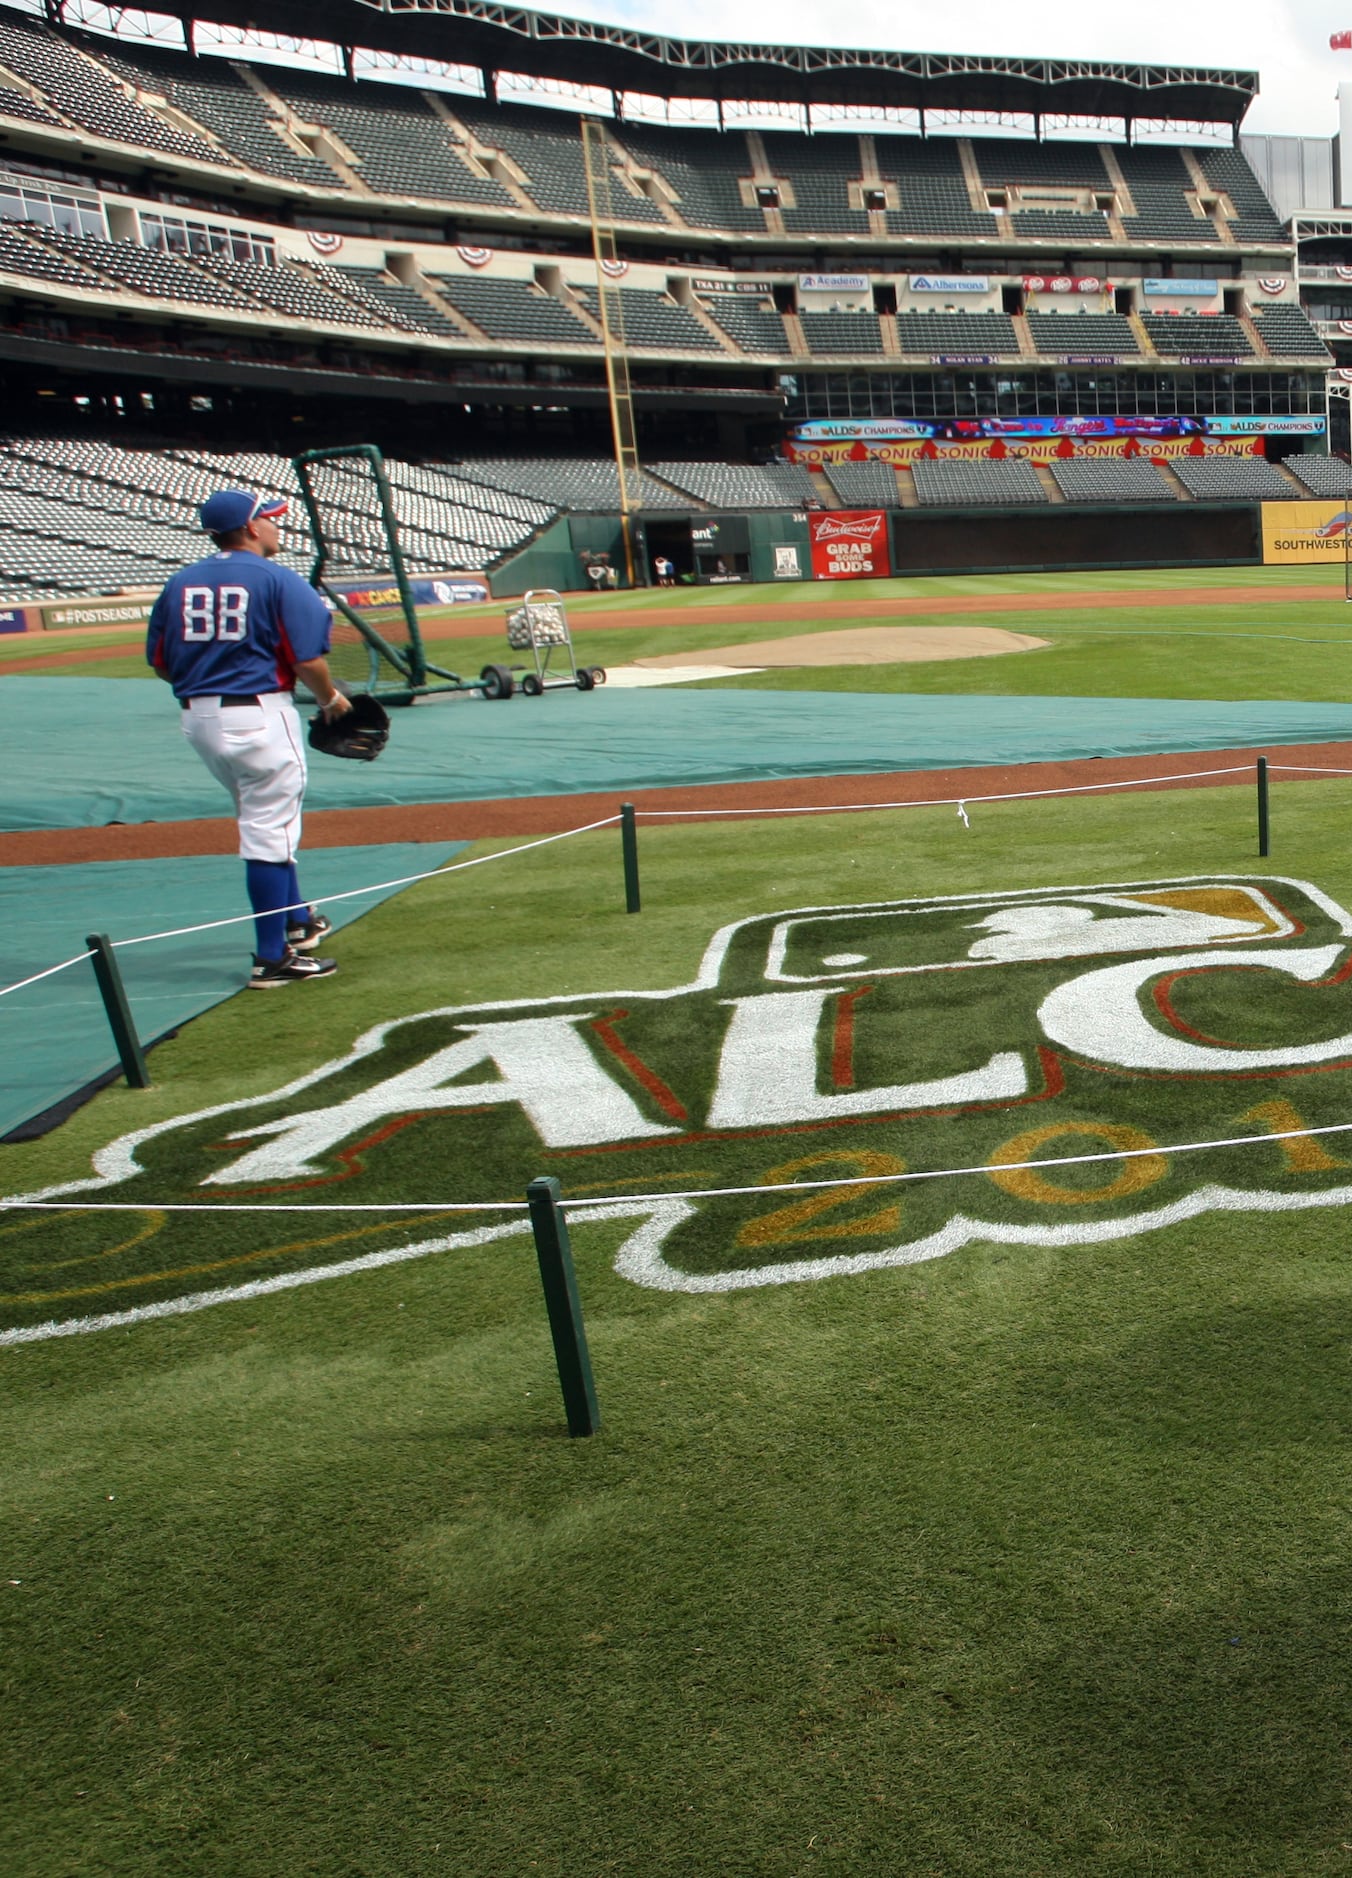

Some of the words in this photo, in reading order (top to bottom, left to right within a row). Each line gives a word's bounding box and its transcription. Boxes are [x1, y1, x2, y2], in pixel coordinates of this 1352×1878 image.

[817, 276, 864, 288] Academy
[933, 279, 985, 290] Albertsons
[829, 426, 856, 435] ALDS
[864, 426, 915, 434] CHAMPIONS
[1237, 422, 1262, 431] ALDS
[1268, 423, 1313, 431] CHAMPIONS
[869, 448, 921, 460] SONIC
[938, 446, 990, 459] SONIC
[1008, 445, 1058, 458] SONIC
[1077, 443, 1125, 456] SONIC
[1143, 443, 1190, 455] SONIC
[1206, 442, 1253, 455] SONIC
[799, 449, 851, 461] SONIC
[813, 522, 880, 536] Budweiser
[827, 543, 872, 555] GRAB
[829, 561, 873, 573] BUDS
[66, 606, 142, 623] #POSTSEASON
